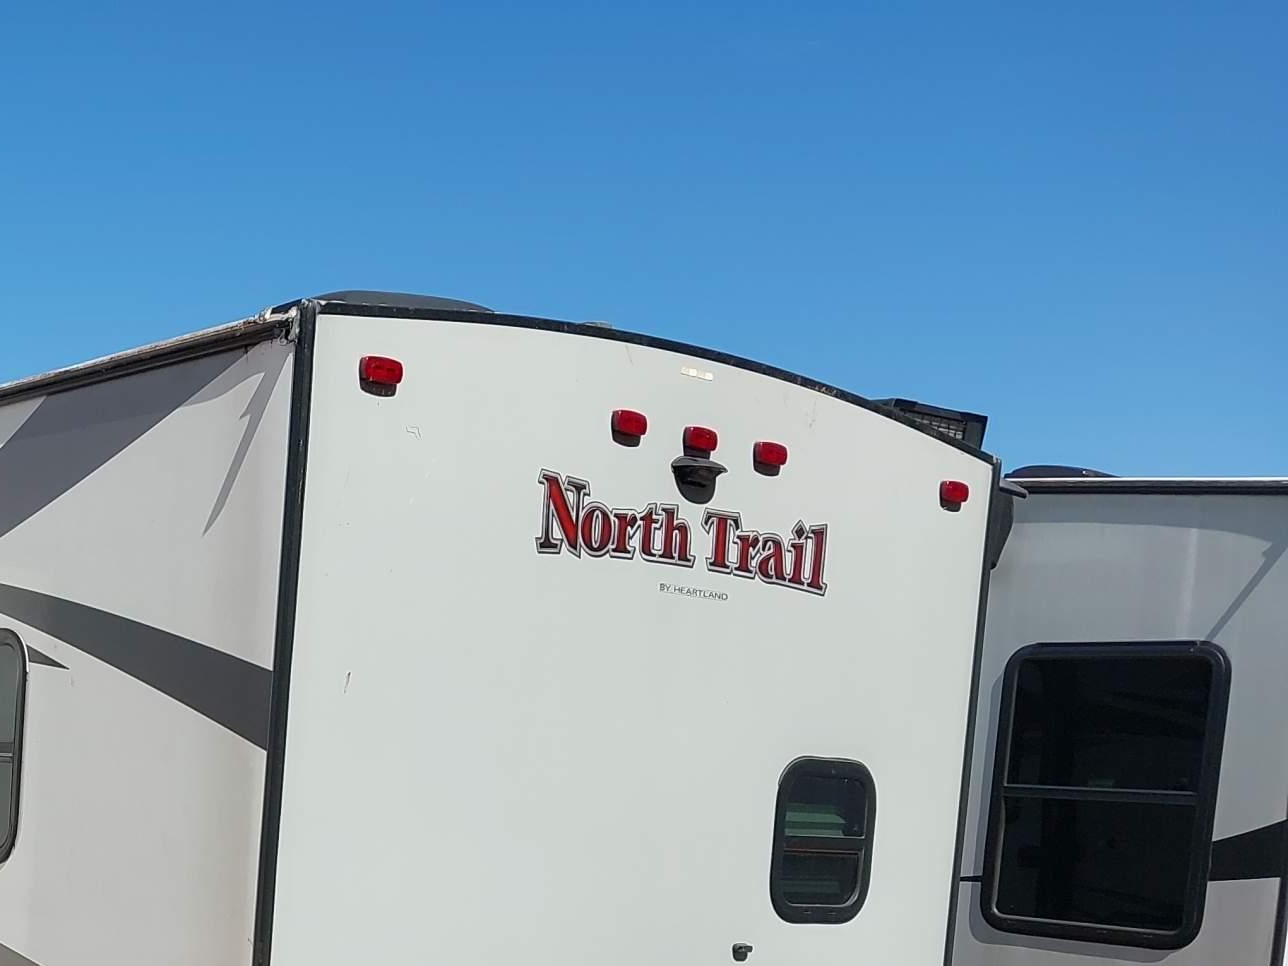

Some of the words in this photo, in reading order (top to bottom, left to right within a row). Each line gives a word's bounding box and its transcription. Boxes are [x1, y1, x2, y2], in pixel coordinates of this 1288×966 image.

[535, 469, 696, 568] North
[701, 508, 828, 597] Trail
[659, 583, 671, 592] BY
[673, 585, 729, 601] HEARTLAND
